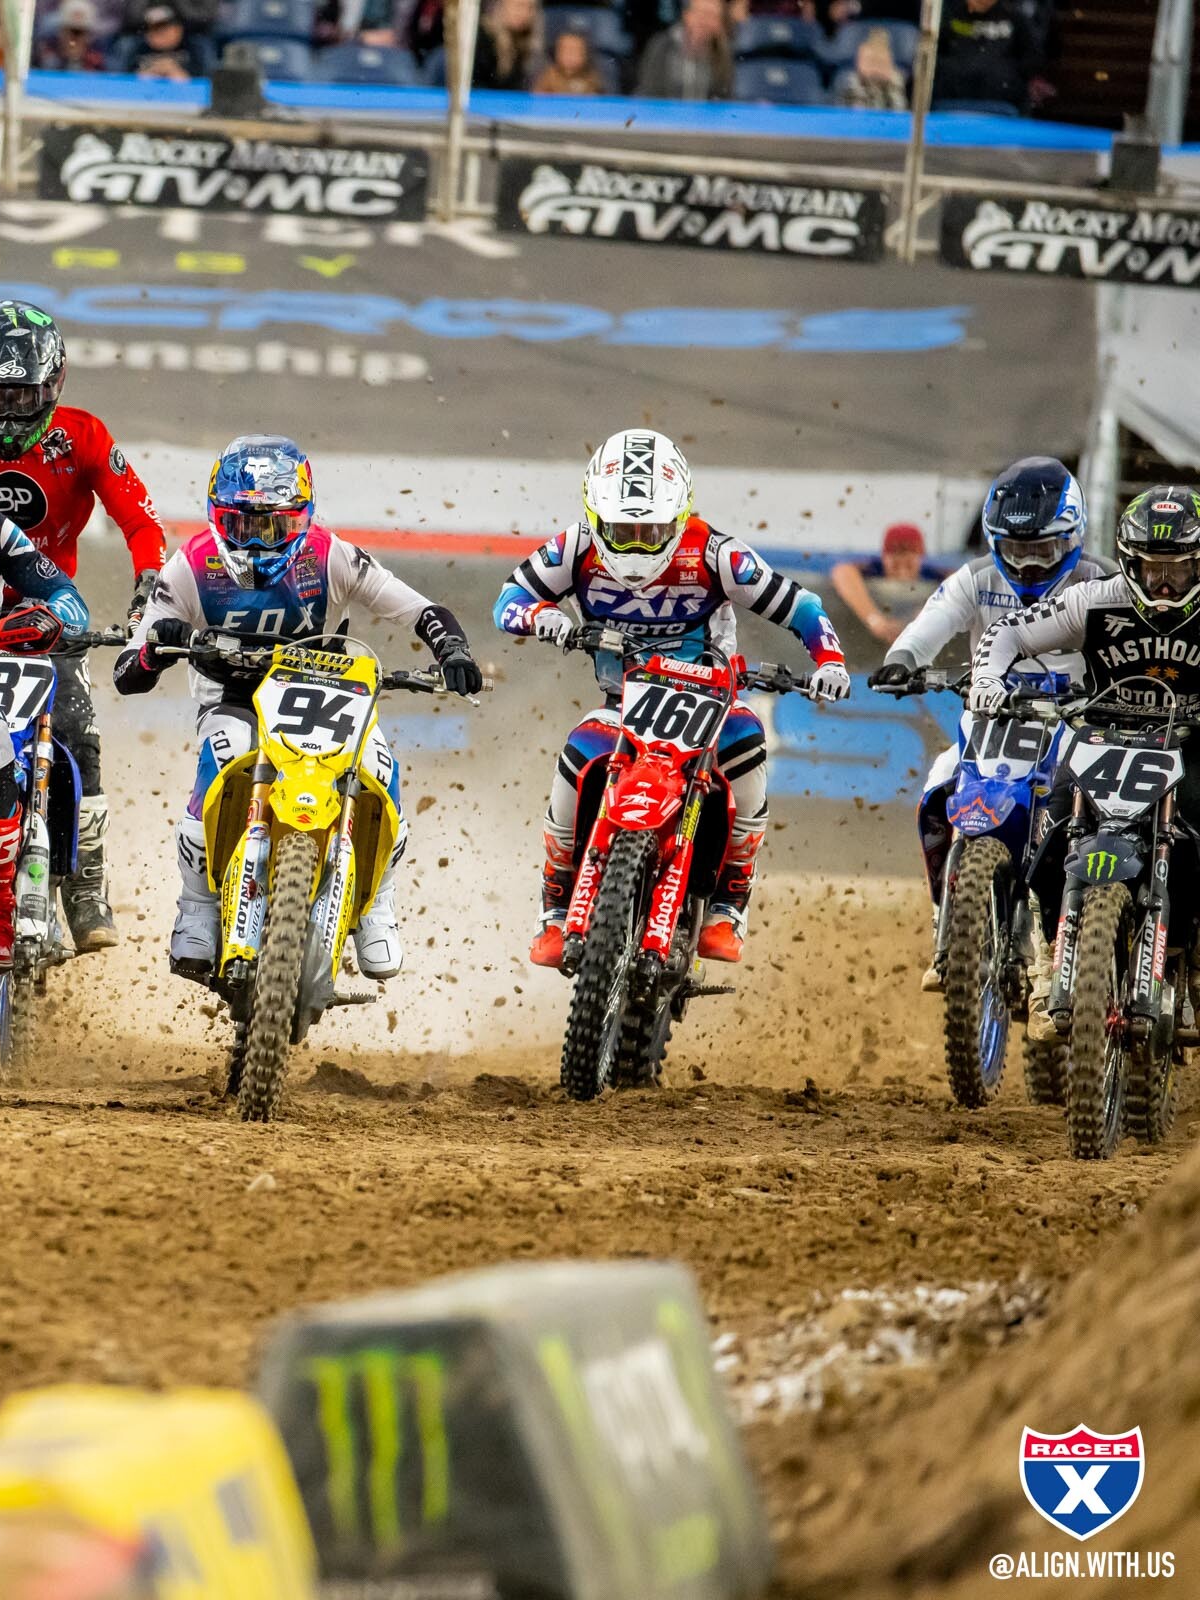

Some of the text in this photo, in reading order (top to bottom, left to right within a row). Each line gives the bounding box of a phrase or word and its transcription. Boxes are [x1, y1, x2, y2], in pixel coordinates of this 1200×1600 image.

[117, 132, 406, 178] ROCKY MOUNTAIN
[575, 164, 865, 217] ROCKY MOUNTAIN
[1018, 200, 1129, 239] ROCKY
[221, 601, 316, 635] FOX
[586, 576, 709, 618] FXR
[605, 618, 686, 636] MOTO
[309, 676, 340, 686] MONSTER
[662, 659, 712, 680] PROTAPER
[270, 687, 356, 744] 94
[623, 686, 718, 749] 460
[961, 720, 1050, 763] 116
[1079, 749, 1175, 802] 46
[236, 858, 255, 939] DUNLOP
[1139, 915, 1156, 997] DUNLOP
[1153, 927, 1167, 977] MOTUL
